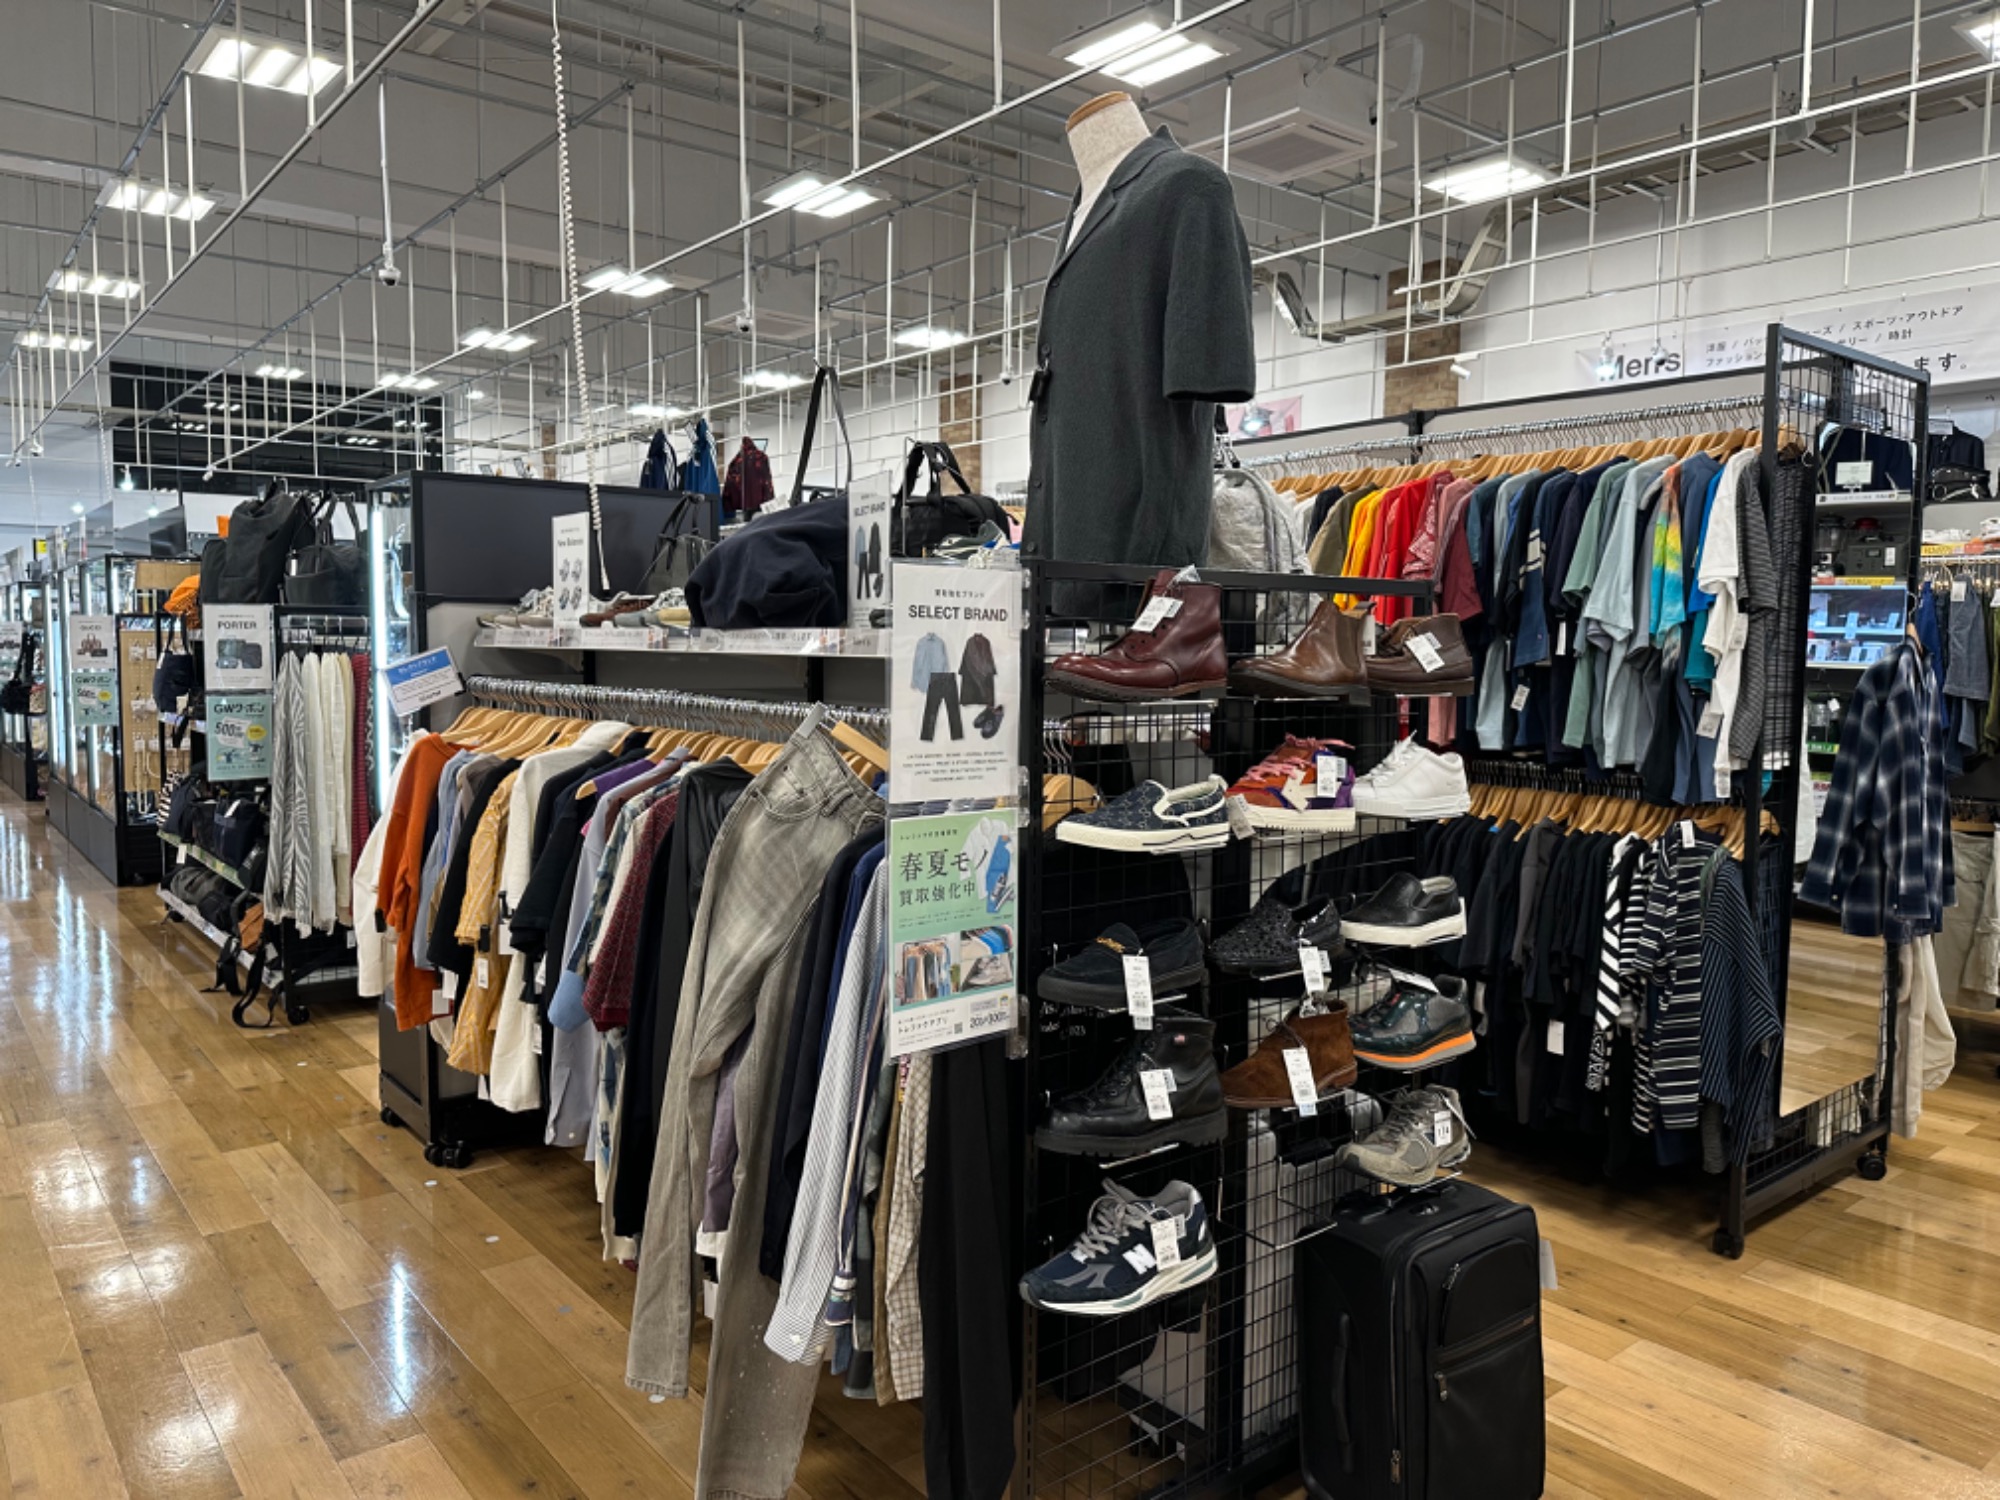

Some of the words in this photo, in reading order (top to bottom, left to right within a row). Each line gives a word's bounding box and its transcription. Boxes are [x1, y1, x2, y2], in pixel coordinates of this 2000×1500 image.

[1852, 305, 1964, 331] スポーツ・アウトドア
[1888, 328, 1913, 341] 時計
[908, 604, 960, 620] SELECT
[964, 607, 1009, 623] BRAND
[217, 620, 257, 630] PORTER
[900, 848, 989, 882] 春夏モノ
[899, 880, 976, 907] 買取強化中
